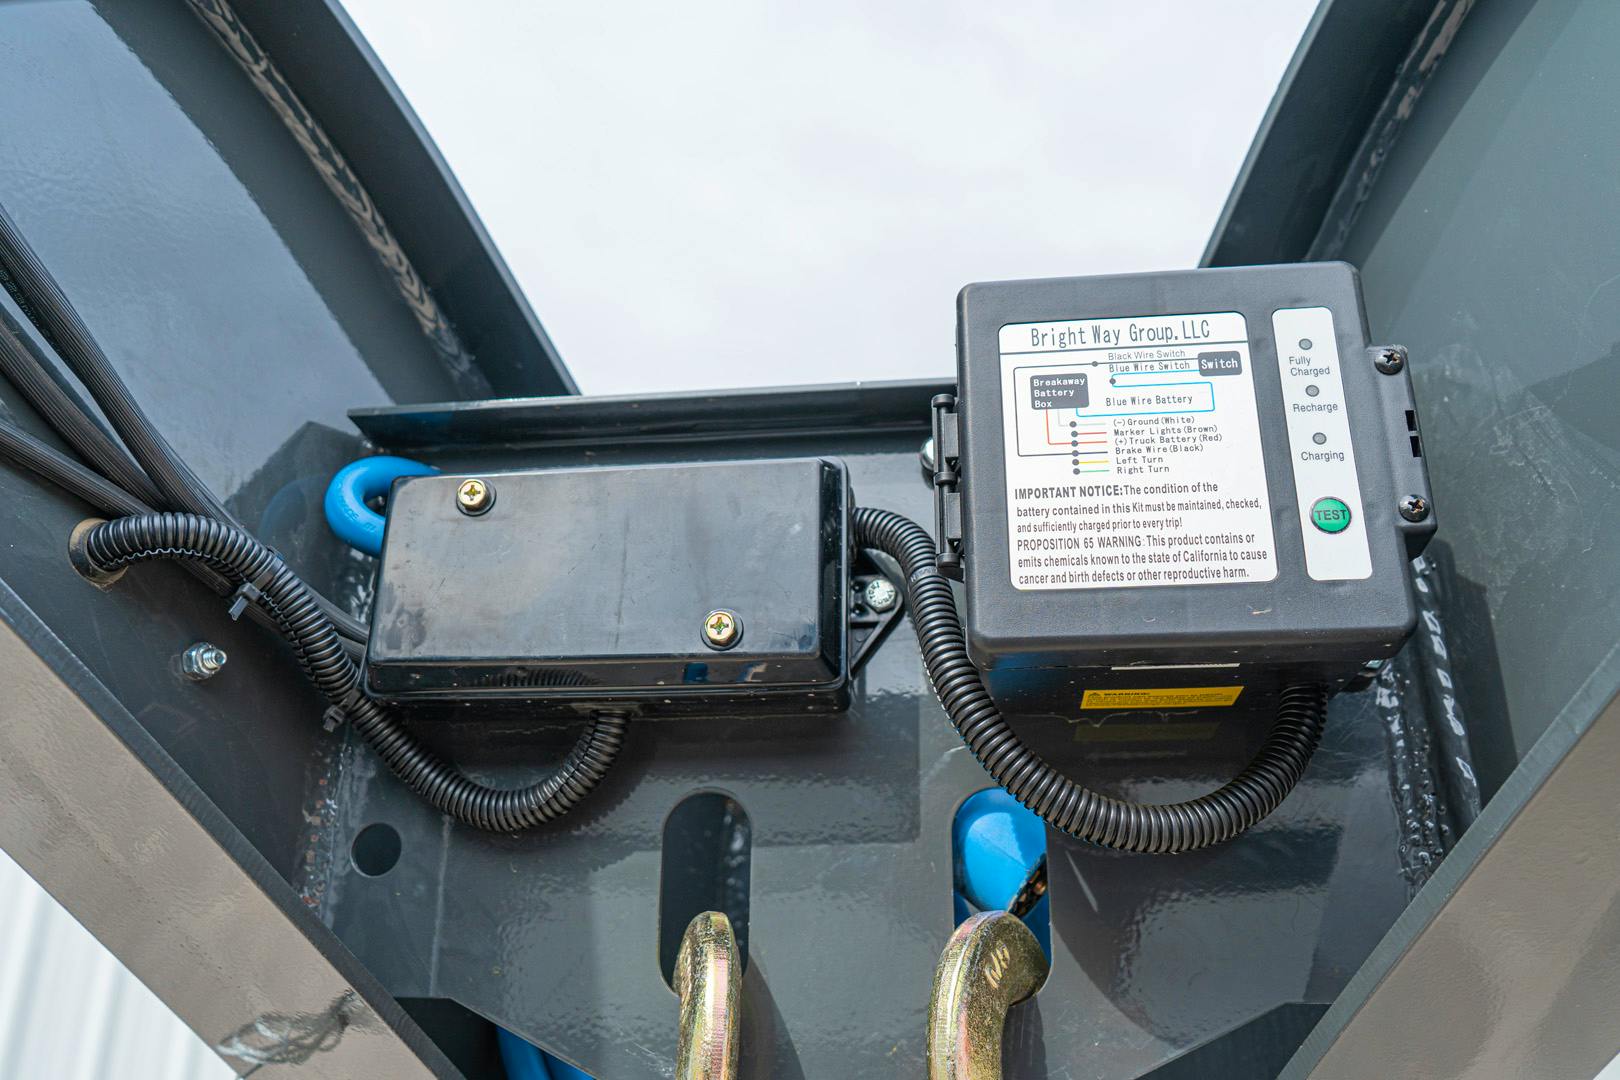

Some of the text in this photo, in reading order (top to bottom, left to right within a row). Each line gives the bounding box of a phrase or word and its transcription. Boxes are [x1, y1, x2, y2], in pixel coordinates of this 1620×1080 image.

[1031, 327, 1086, 348] Bright
[1092, 325, 1121, 345] Way
[1108, 349, 1185, 361] Black Wire Switch
[1201, 359, 1238, 369] Switch
[1289, 356, 1311, 366] Fully
[1109, 361, 1190, 373] Blue Wire Switch
[1291, 367, 1330, 377] Charged
[1033, 377, 1085, 386] Breakaway
[1034, 388, 1074, 398] Battery
[1035, 400, 1052, 408] Box
[1106, 394, 1193, 406] Blue Wire Battery
[1293, 403, 1338, 413] Recharge
[1114, 428, 1145, 436] Marker
[1116, 446, 1142, 454] Brake
[1117, 456, 1138, 464] Left
[1301, 451, 1344, 461] Charging
[1117, 466, 1143, 475] Right
[1015, 487, 1076, 500] IMPORTANT
[1144, 483, 1189, 494] condition
[1192, 483, 1201, 492] of
[1203, 482, 1218, 492] the
[1017, 498, 1262, 518] battery contained in this Kit must be maintained, checked,
[1315, 510, 1347, 521] TEST
[1017, 517, 1182, 533] and sufficiently charged prior to every trip!
[1017, 533, 1255, 551] PROPOSITION 65 WARNING: This product contains or
[1018, 550, 1267, 568] emits chemicals known to the state of California to cause
[1019, 567, 1249, 584] cancer and birth defects or other reproductive harm.
